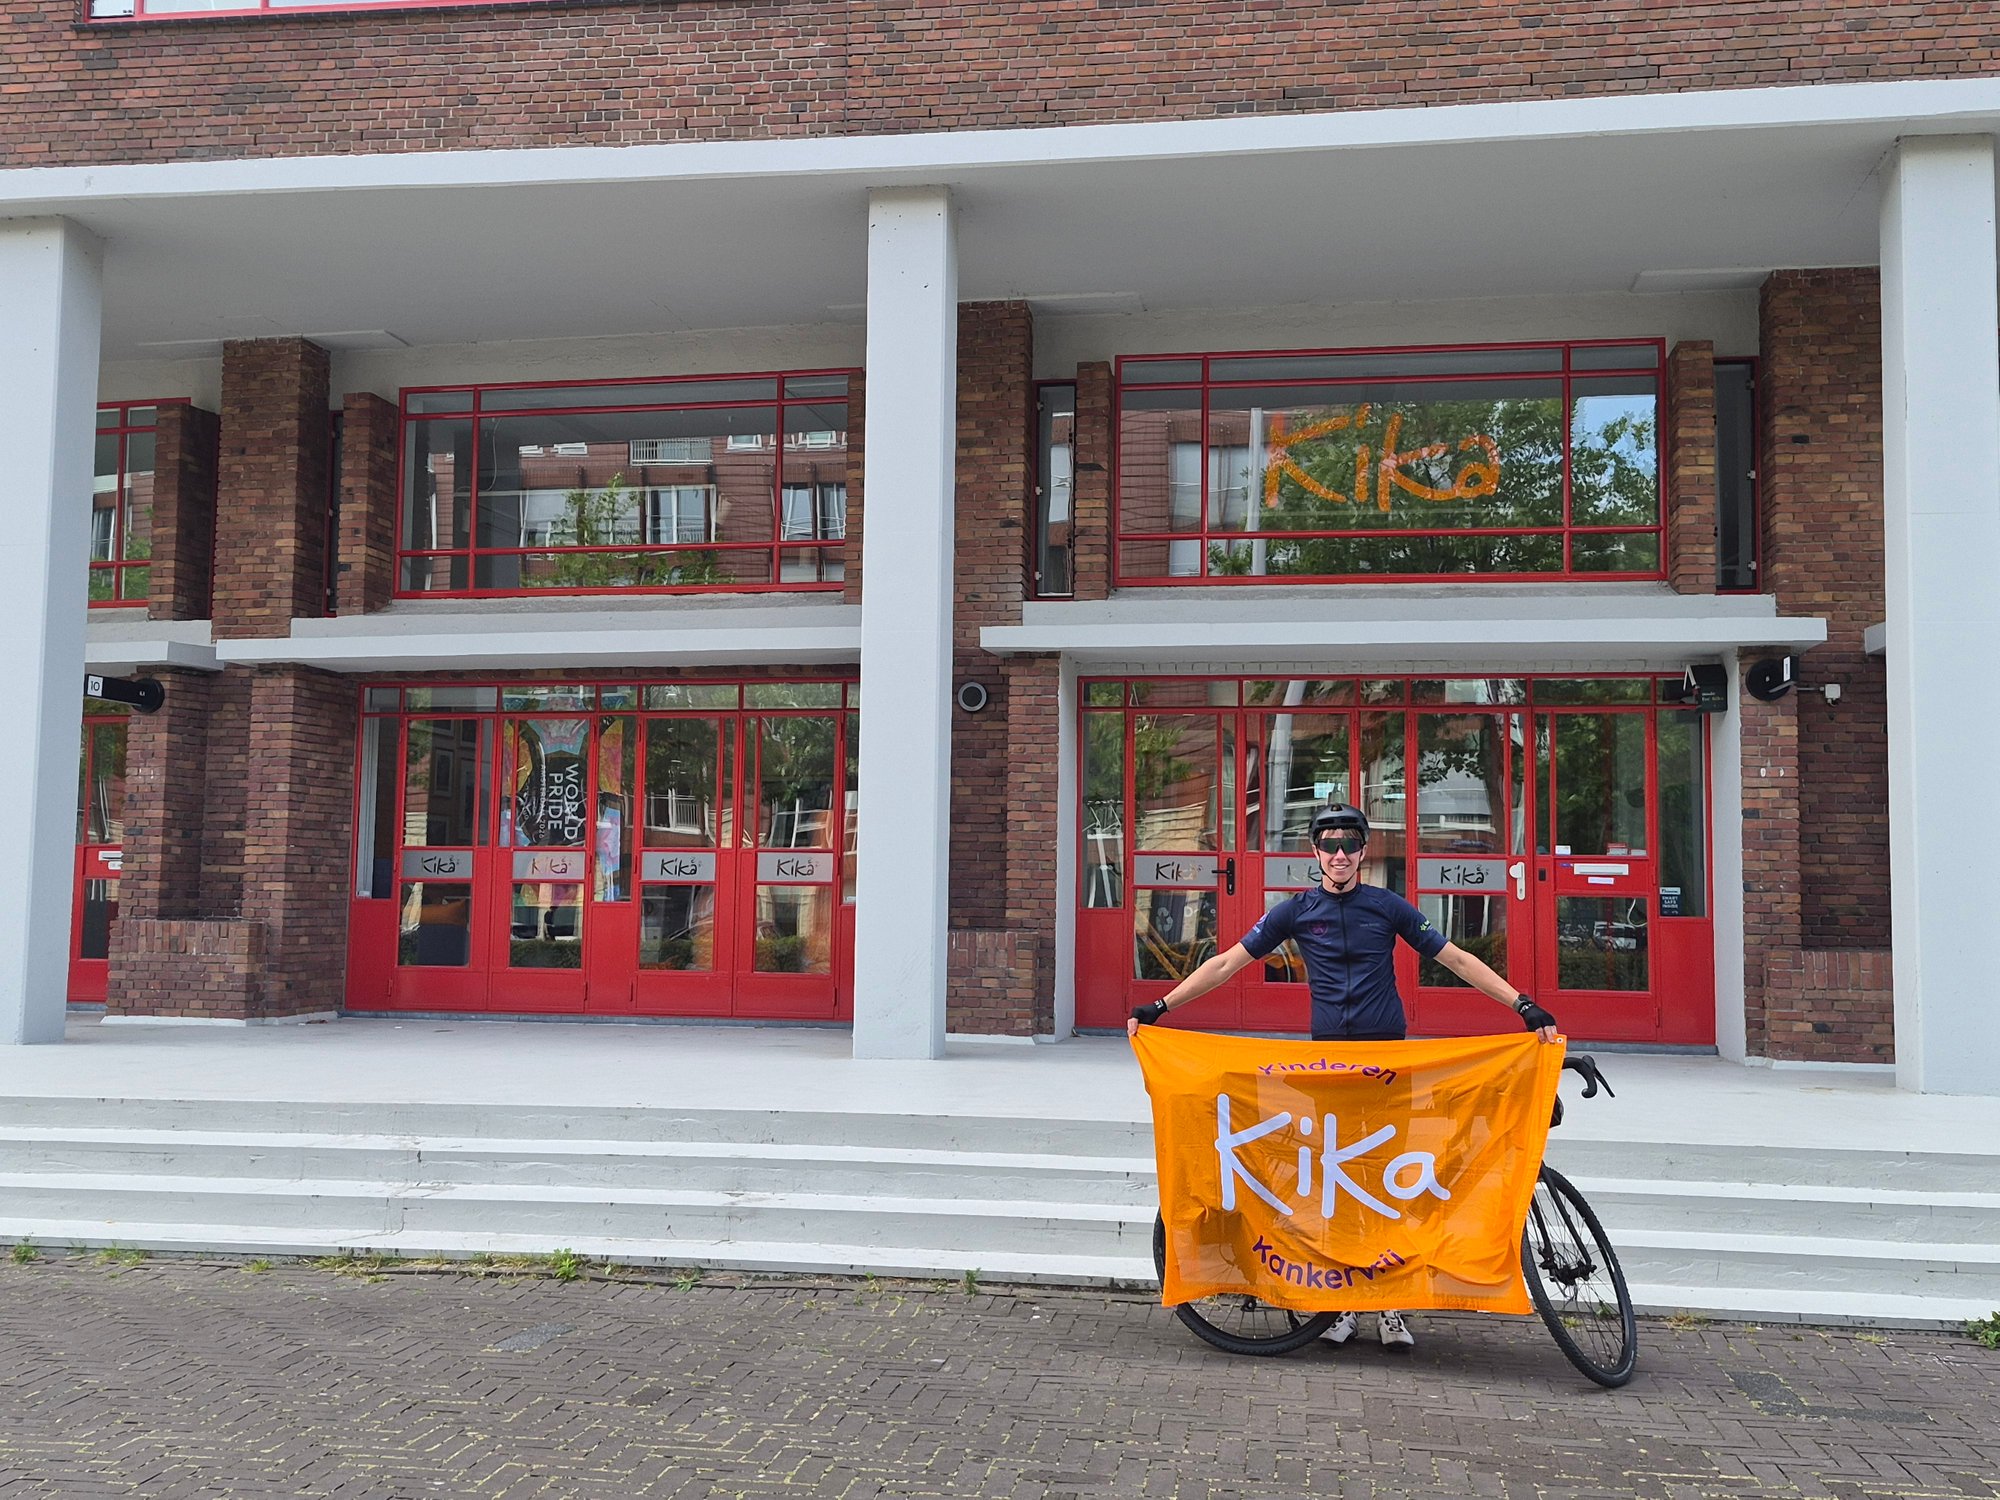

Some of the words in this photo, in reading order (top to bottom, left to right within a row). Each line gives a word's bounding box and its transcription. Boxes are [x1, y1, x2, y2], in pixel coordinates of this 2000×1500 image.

[547, 772, 563, 831] PRIDE
[564, 763, 580, 840] WORLD
[1257, 1058, 1397, 1085] Kinderen
